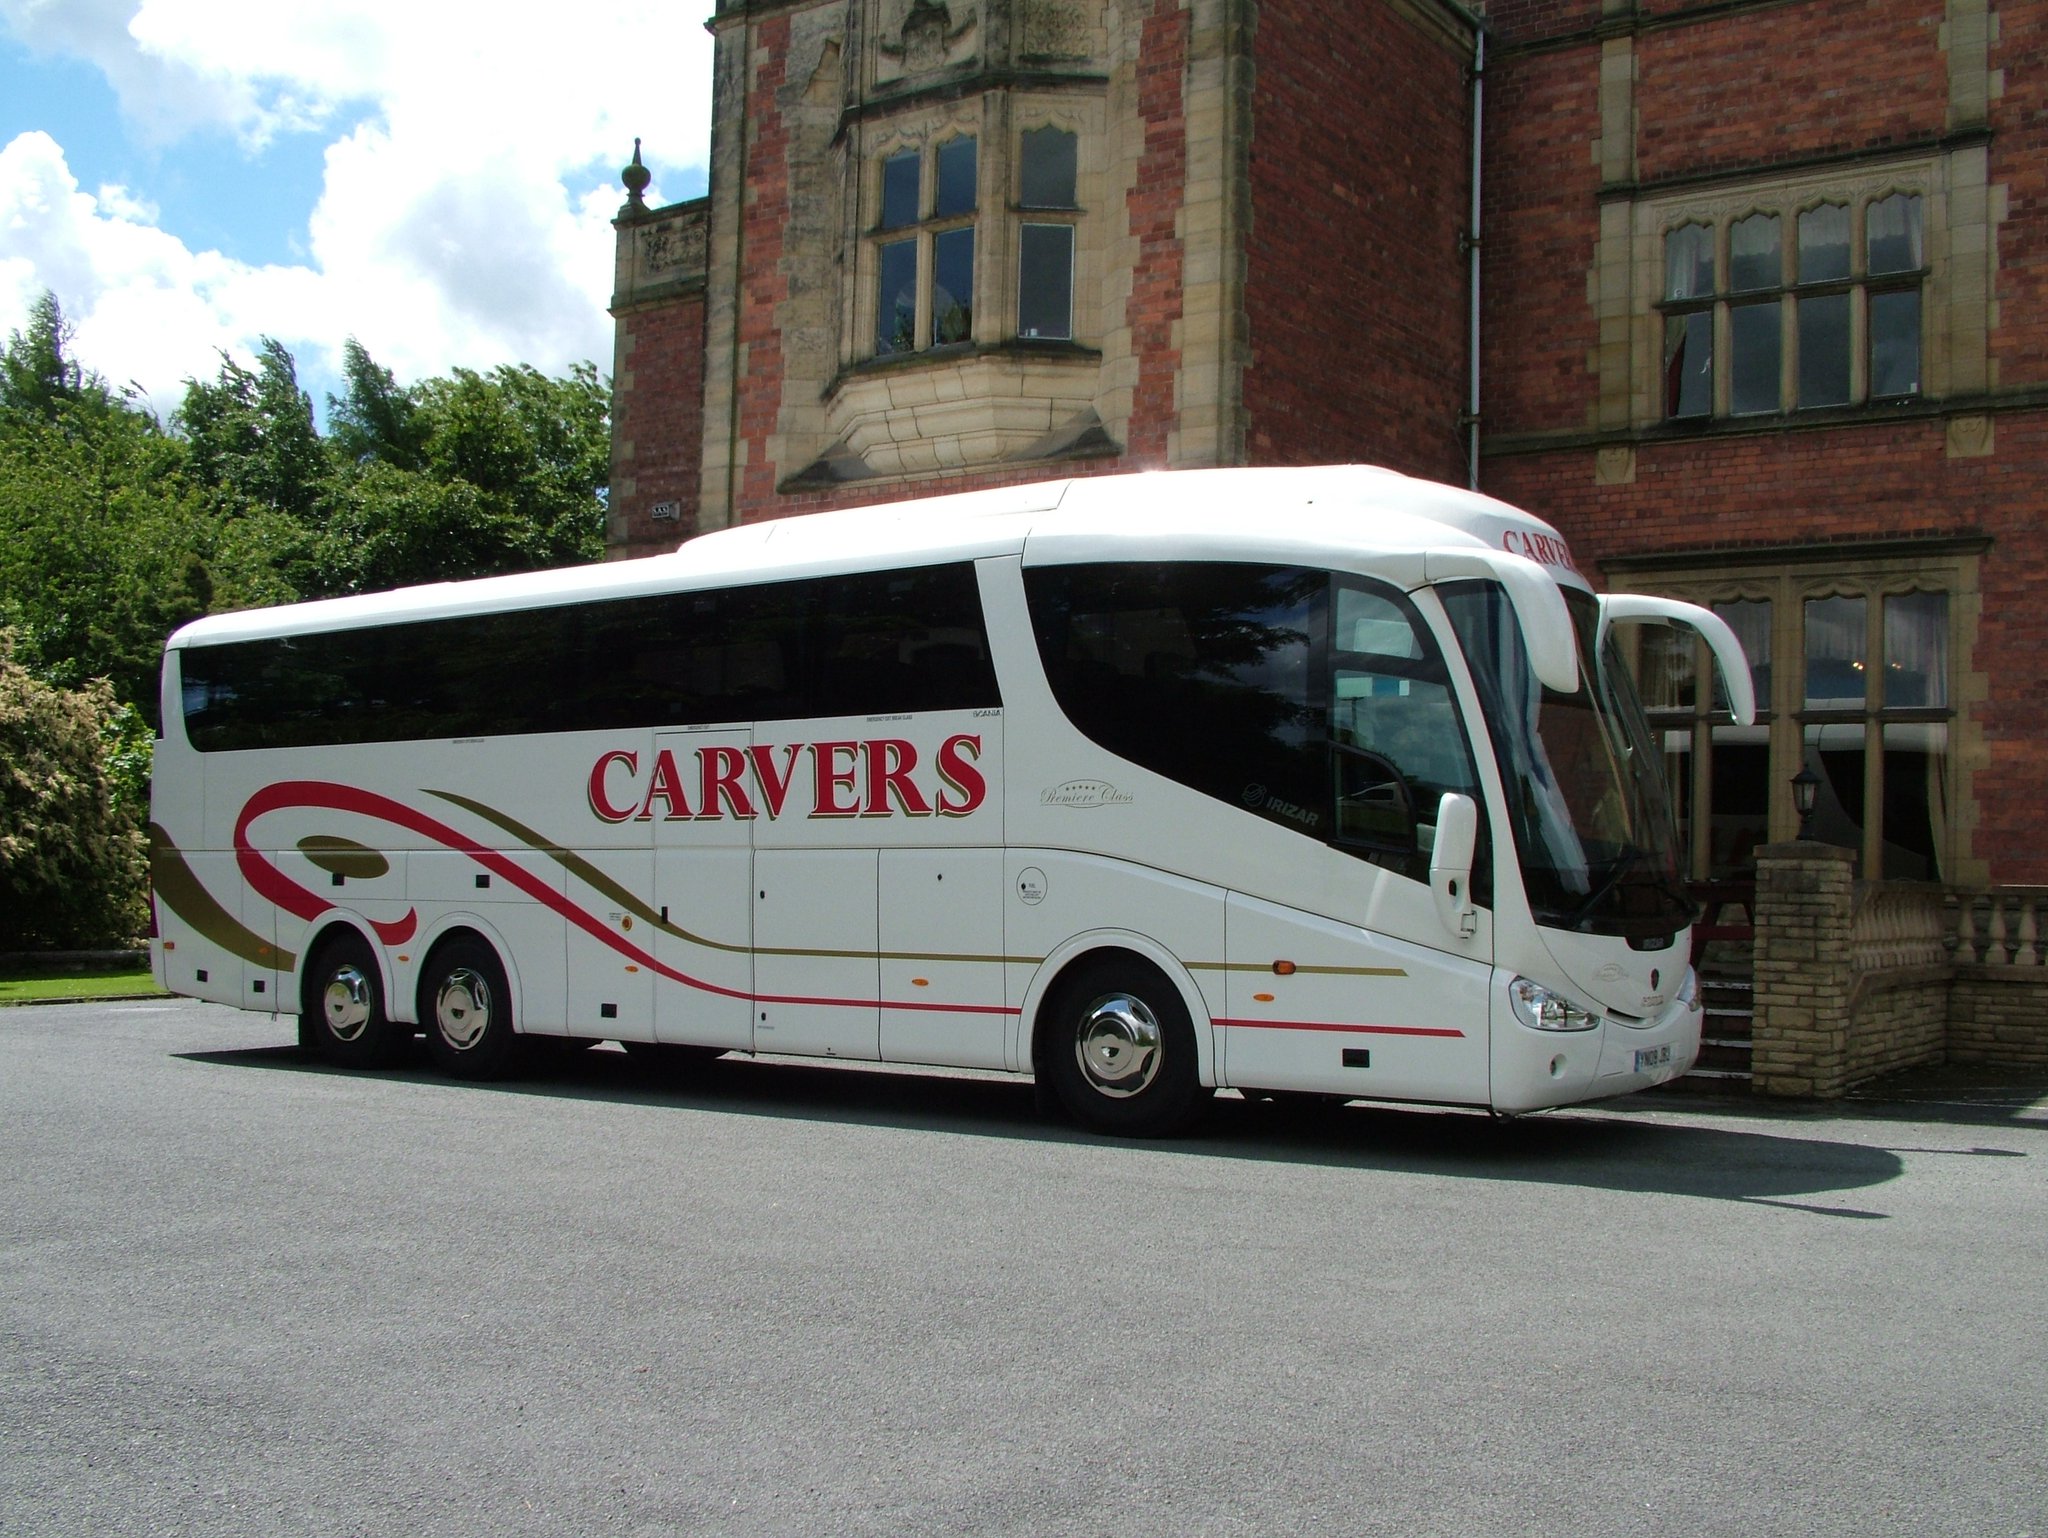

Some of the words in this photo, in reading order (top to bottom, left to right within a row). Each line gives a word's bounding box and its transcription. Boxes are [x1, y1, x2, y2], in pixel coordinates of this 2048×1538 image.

[587, 734, 987, 823] CARVERS
[1100, 785, 1134, 801] Class
[1266, 796, 1319, 826] IRIZAR
